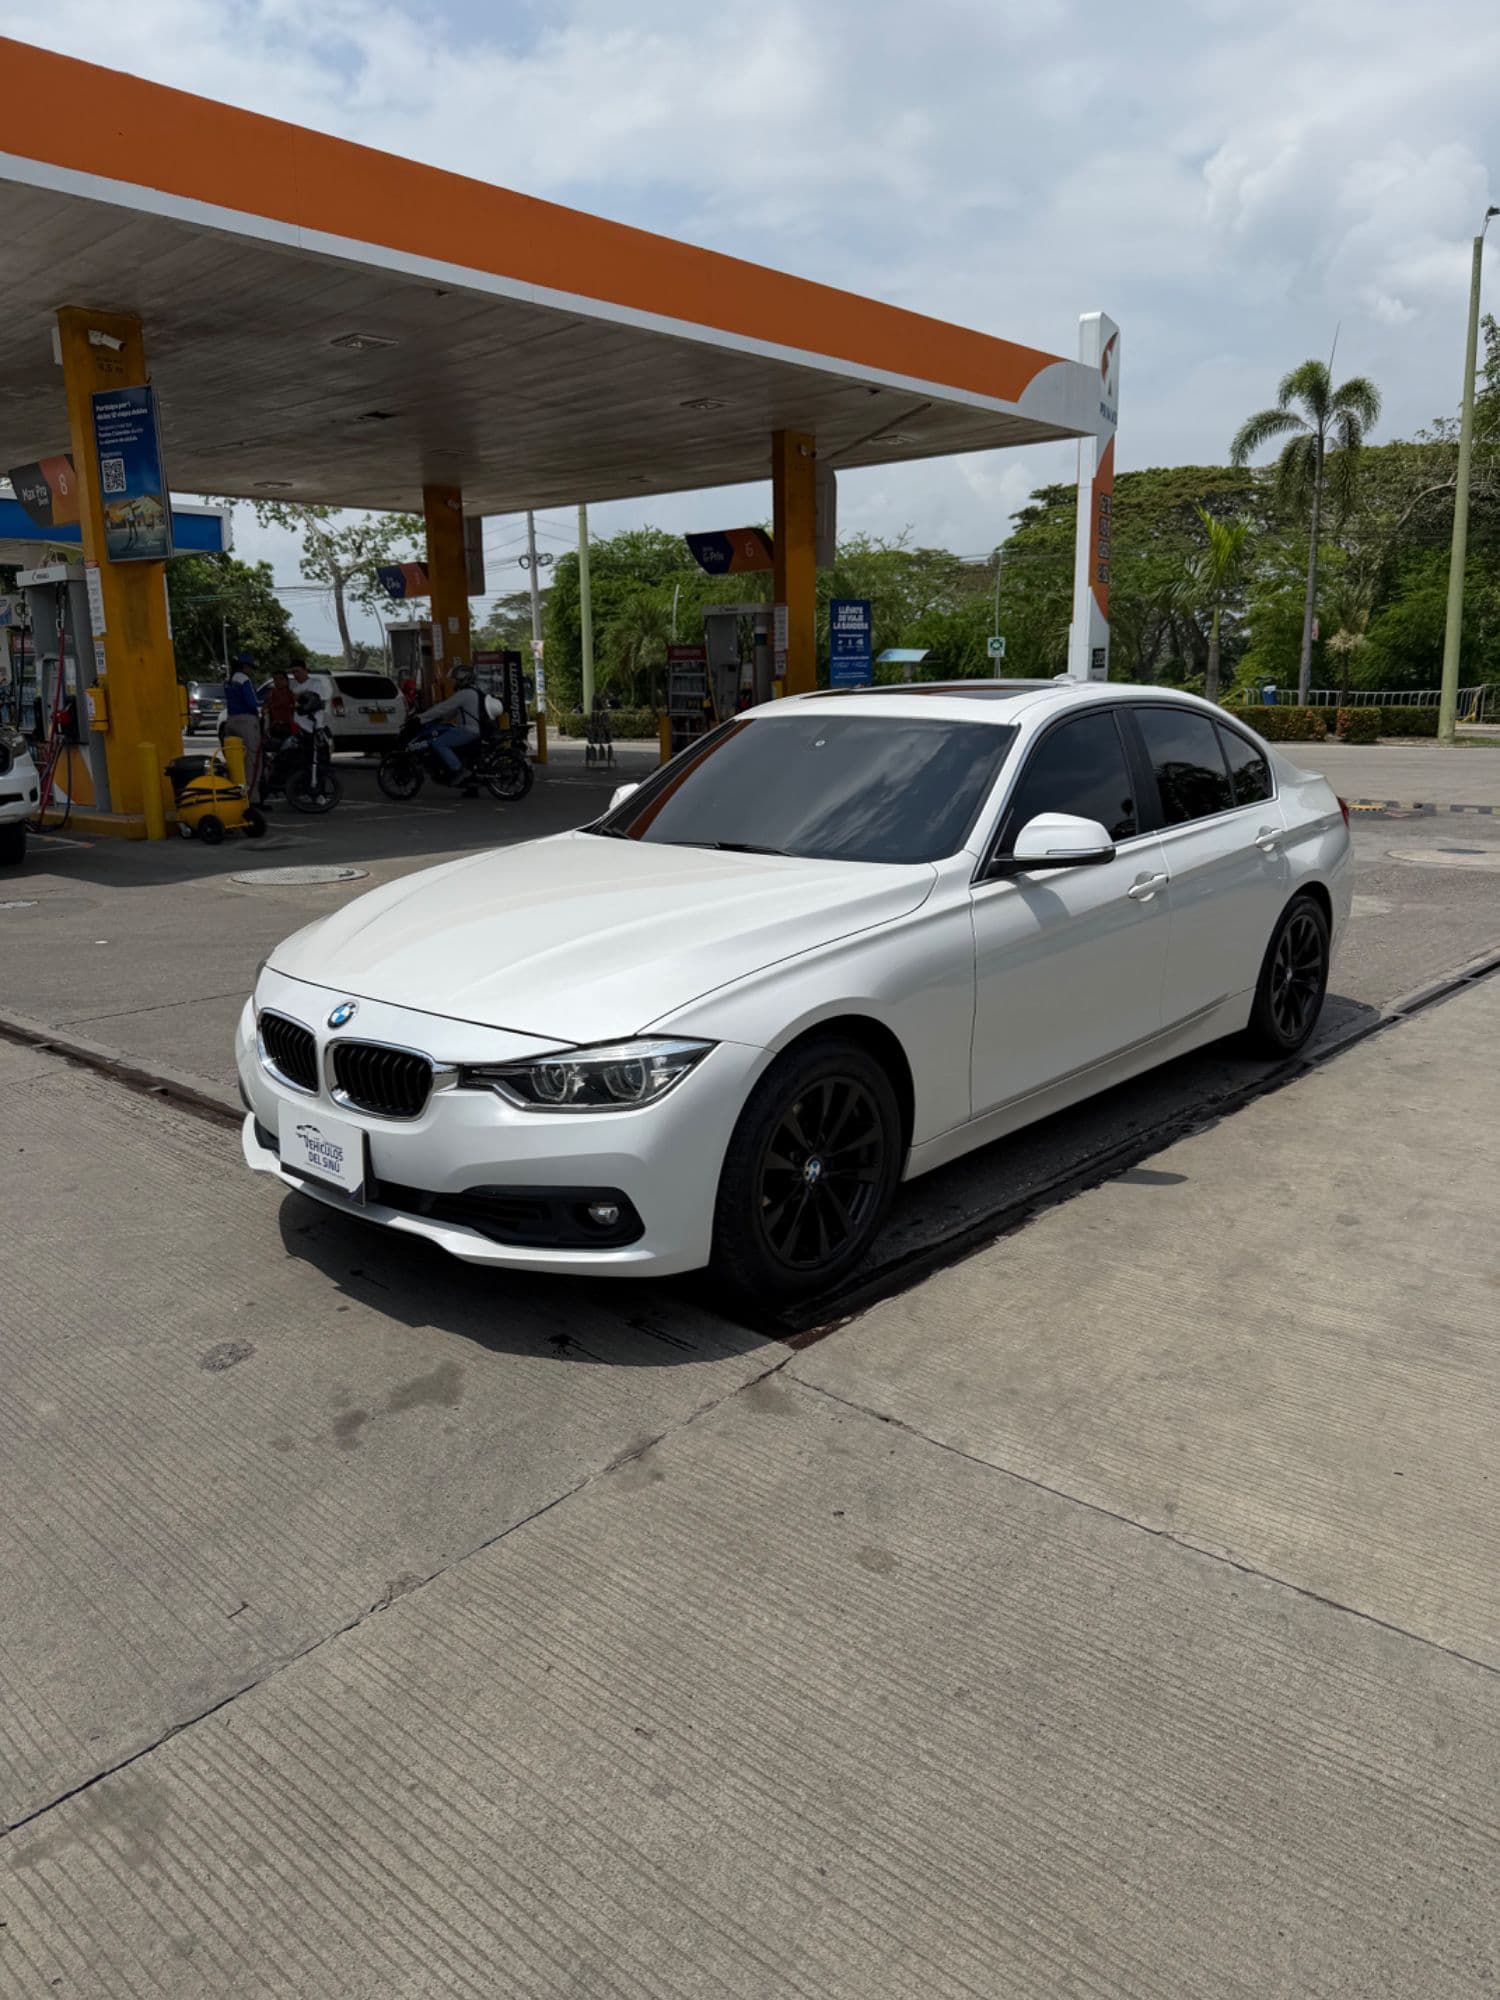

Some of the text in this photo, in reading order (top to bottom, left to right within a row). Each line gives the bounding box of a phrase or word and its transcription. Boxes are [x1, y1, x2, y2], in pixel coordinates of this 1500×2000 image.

[58, 473, 68, 496] 8
[744, 542, 754, 558] 6
[308, 1151, 322, 1165] DEL
